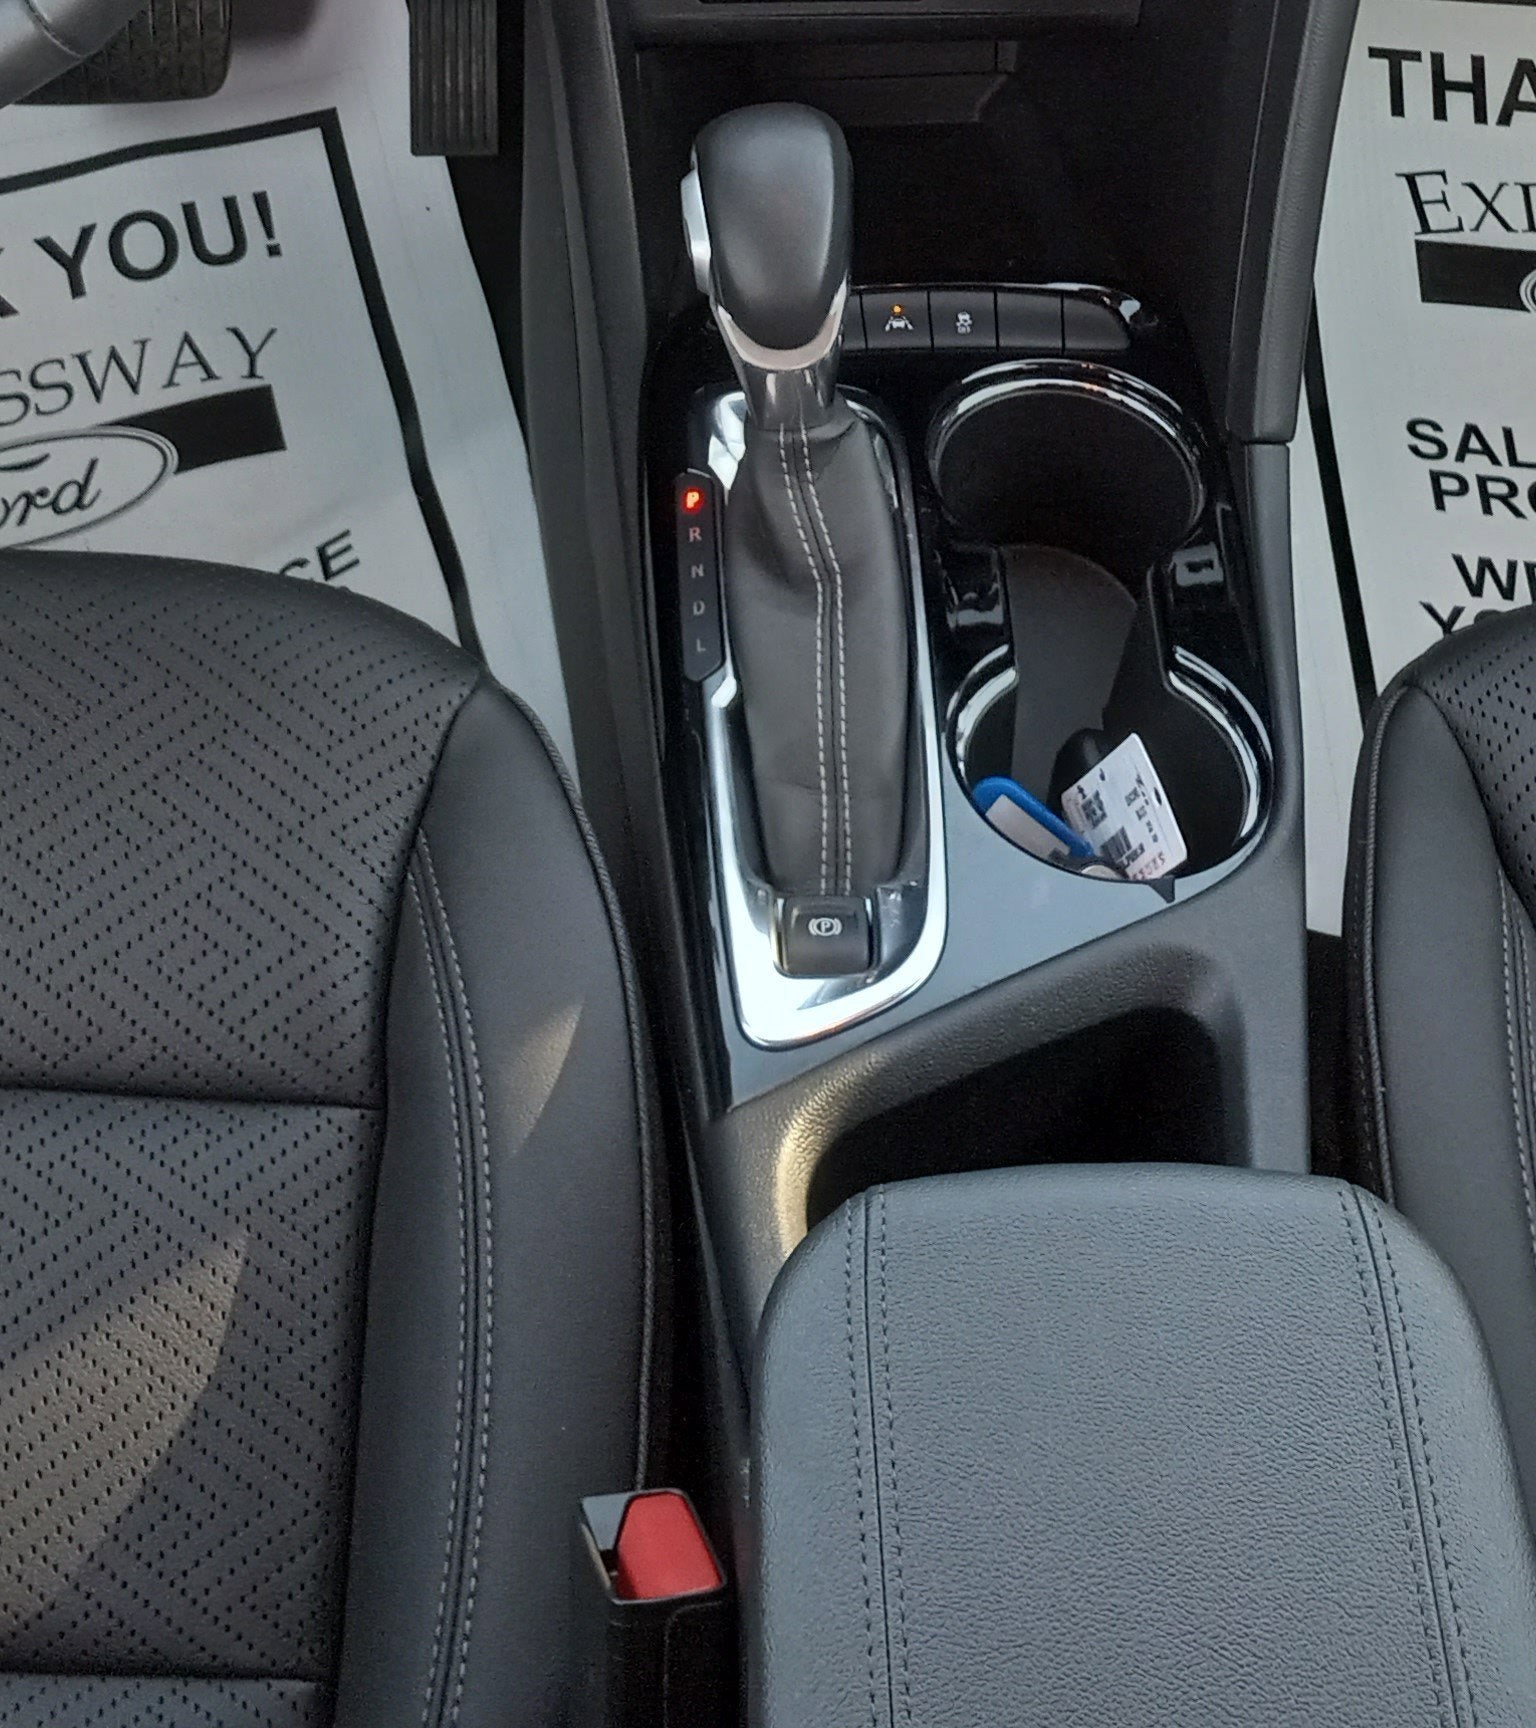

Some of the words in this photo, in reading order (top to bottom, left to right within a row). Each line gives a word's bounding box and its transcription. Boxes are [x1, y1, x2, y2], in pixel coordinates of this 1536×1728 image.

[32, 191, 283, 301] YOU!
[686, 491, 699, 508] P
[689, 527, 702, 542] R
[691, 564, 704, 578] N
[692, 602, 705, 615] D
[696, 639, 706, 652] L
